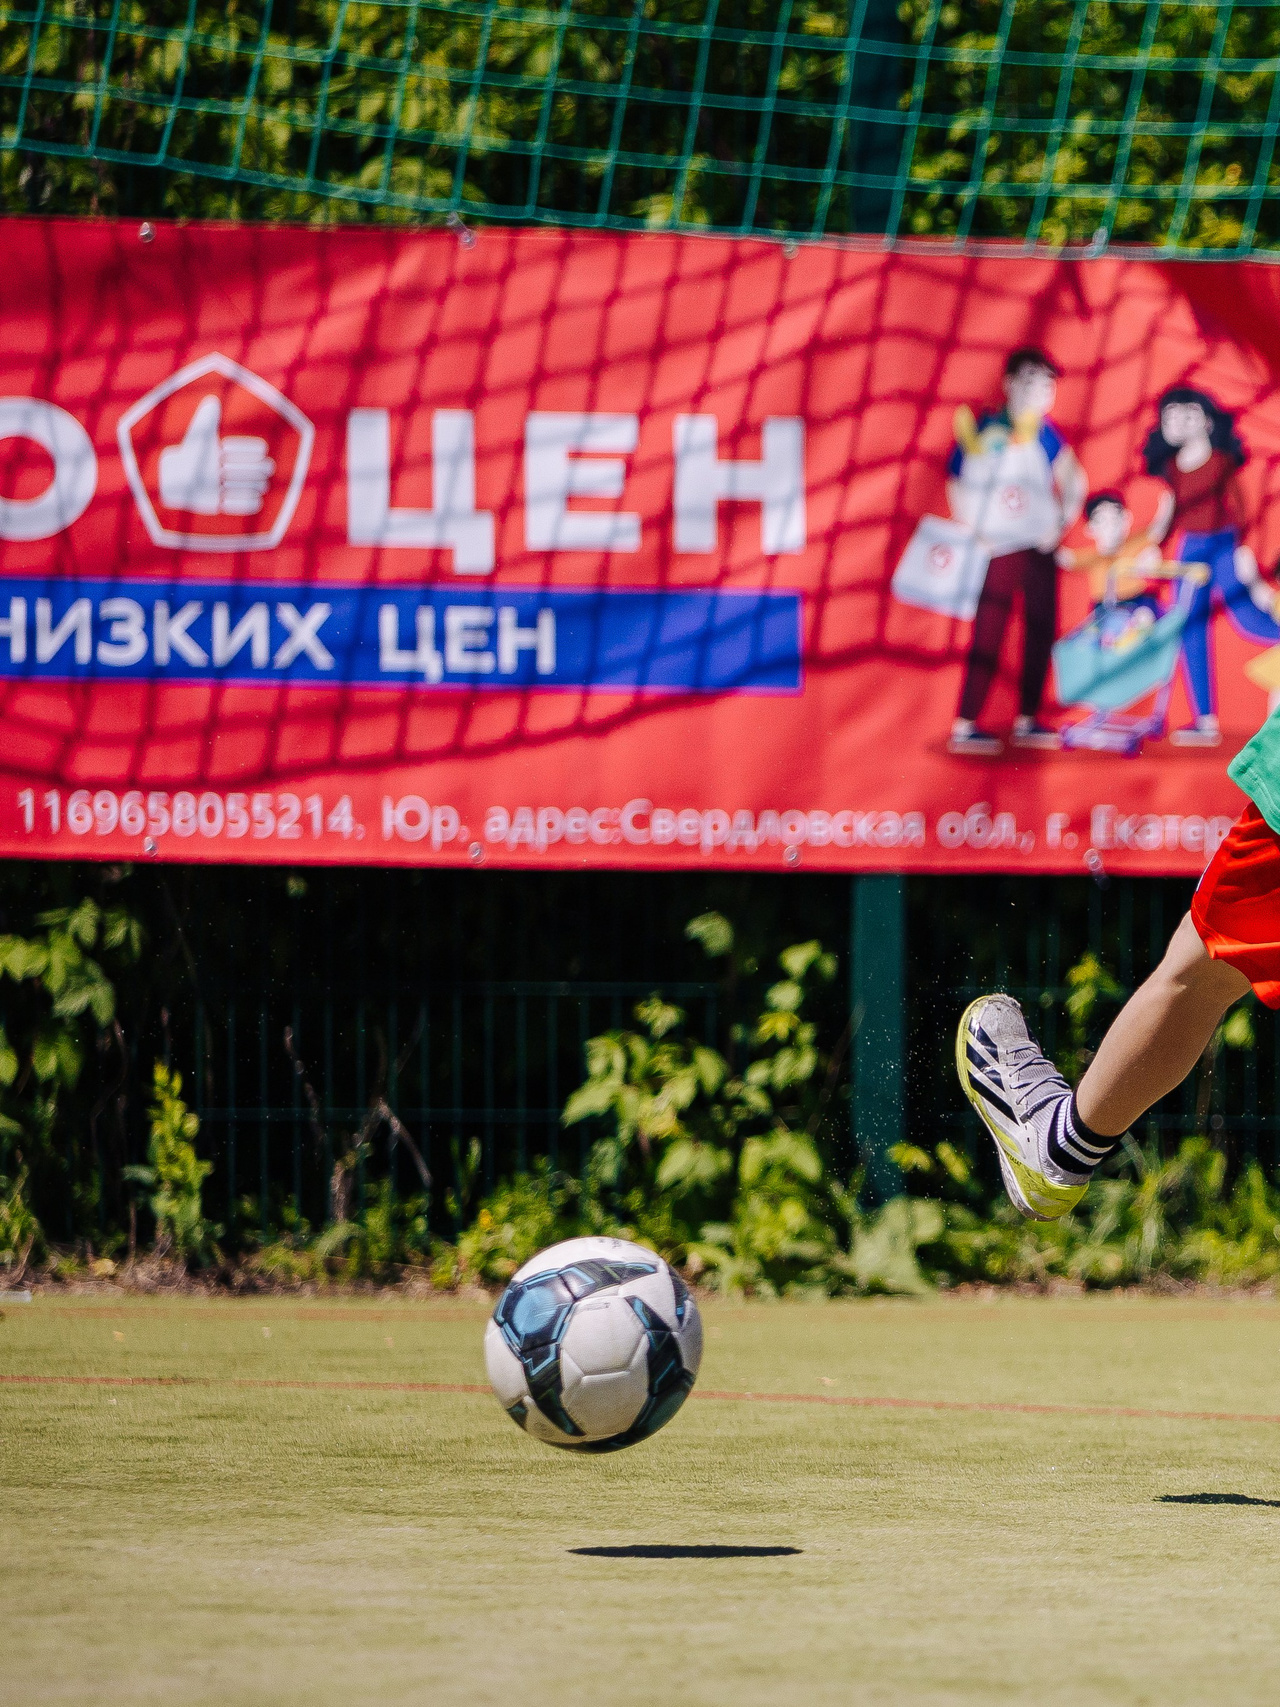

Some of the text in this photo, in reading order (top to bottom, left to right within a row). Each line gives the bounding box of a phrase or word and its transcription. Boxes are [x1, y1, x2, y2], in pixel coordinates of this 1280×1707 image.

[347, 408, 806, 575] ЦЕН
[379, 604, 556, 683] ЦЕН
[1090, 803, 1243, 862] Екатер
